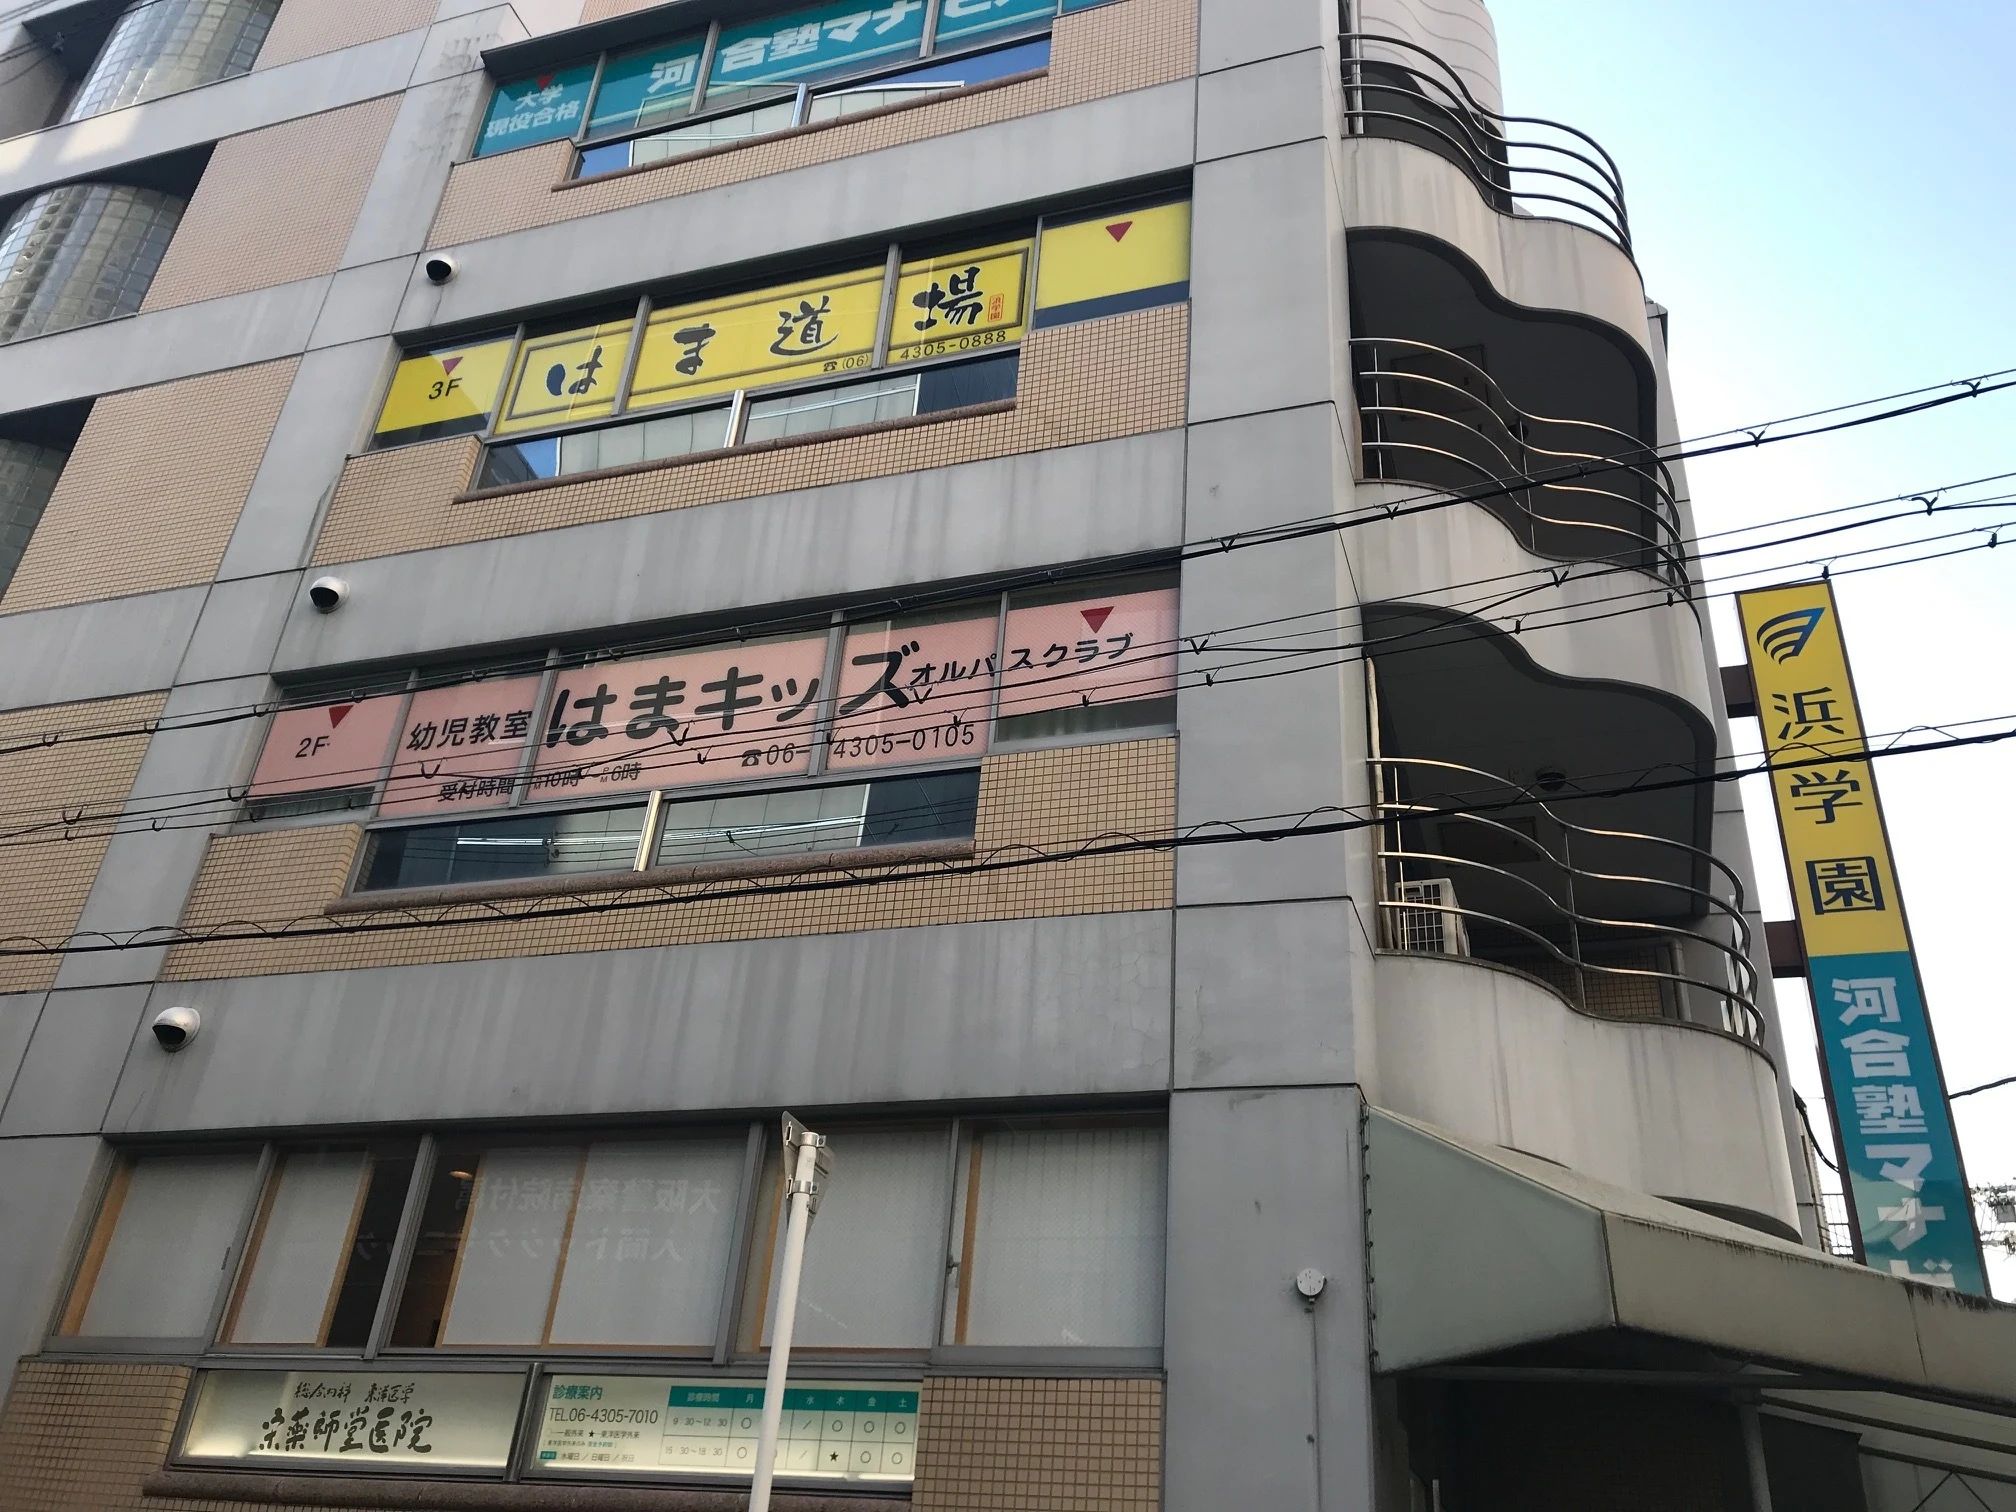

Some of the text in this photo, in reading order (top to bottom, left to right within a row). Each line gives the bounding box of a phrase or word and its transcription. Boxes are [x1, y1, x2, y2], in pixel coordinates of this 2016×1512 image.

[514, 83, 564, 111] 大学
[484, 100, 581, 138] 現役合格
[900, 330, 1007, 360] 4305-0888
[429, 377, 463, 400] 3F
[546, 640, 919, 749] はまキッズ
[406, 709, 533, 752] 幼児教室
[295, 735, 329, 759] 2F
[1772, 686, 1886, 916] 浜学園
[552, 1384, 603, 1401] 診療案内
